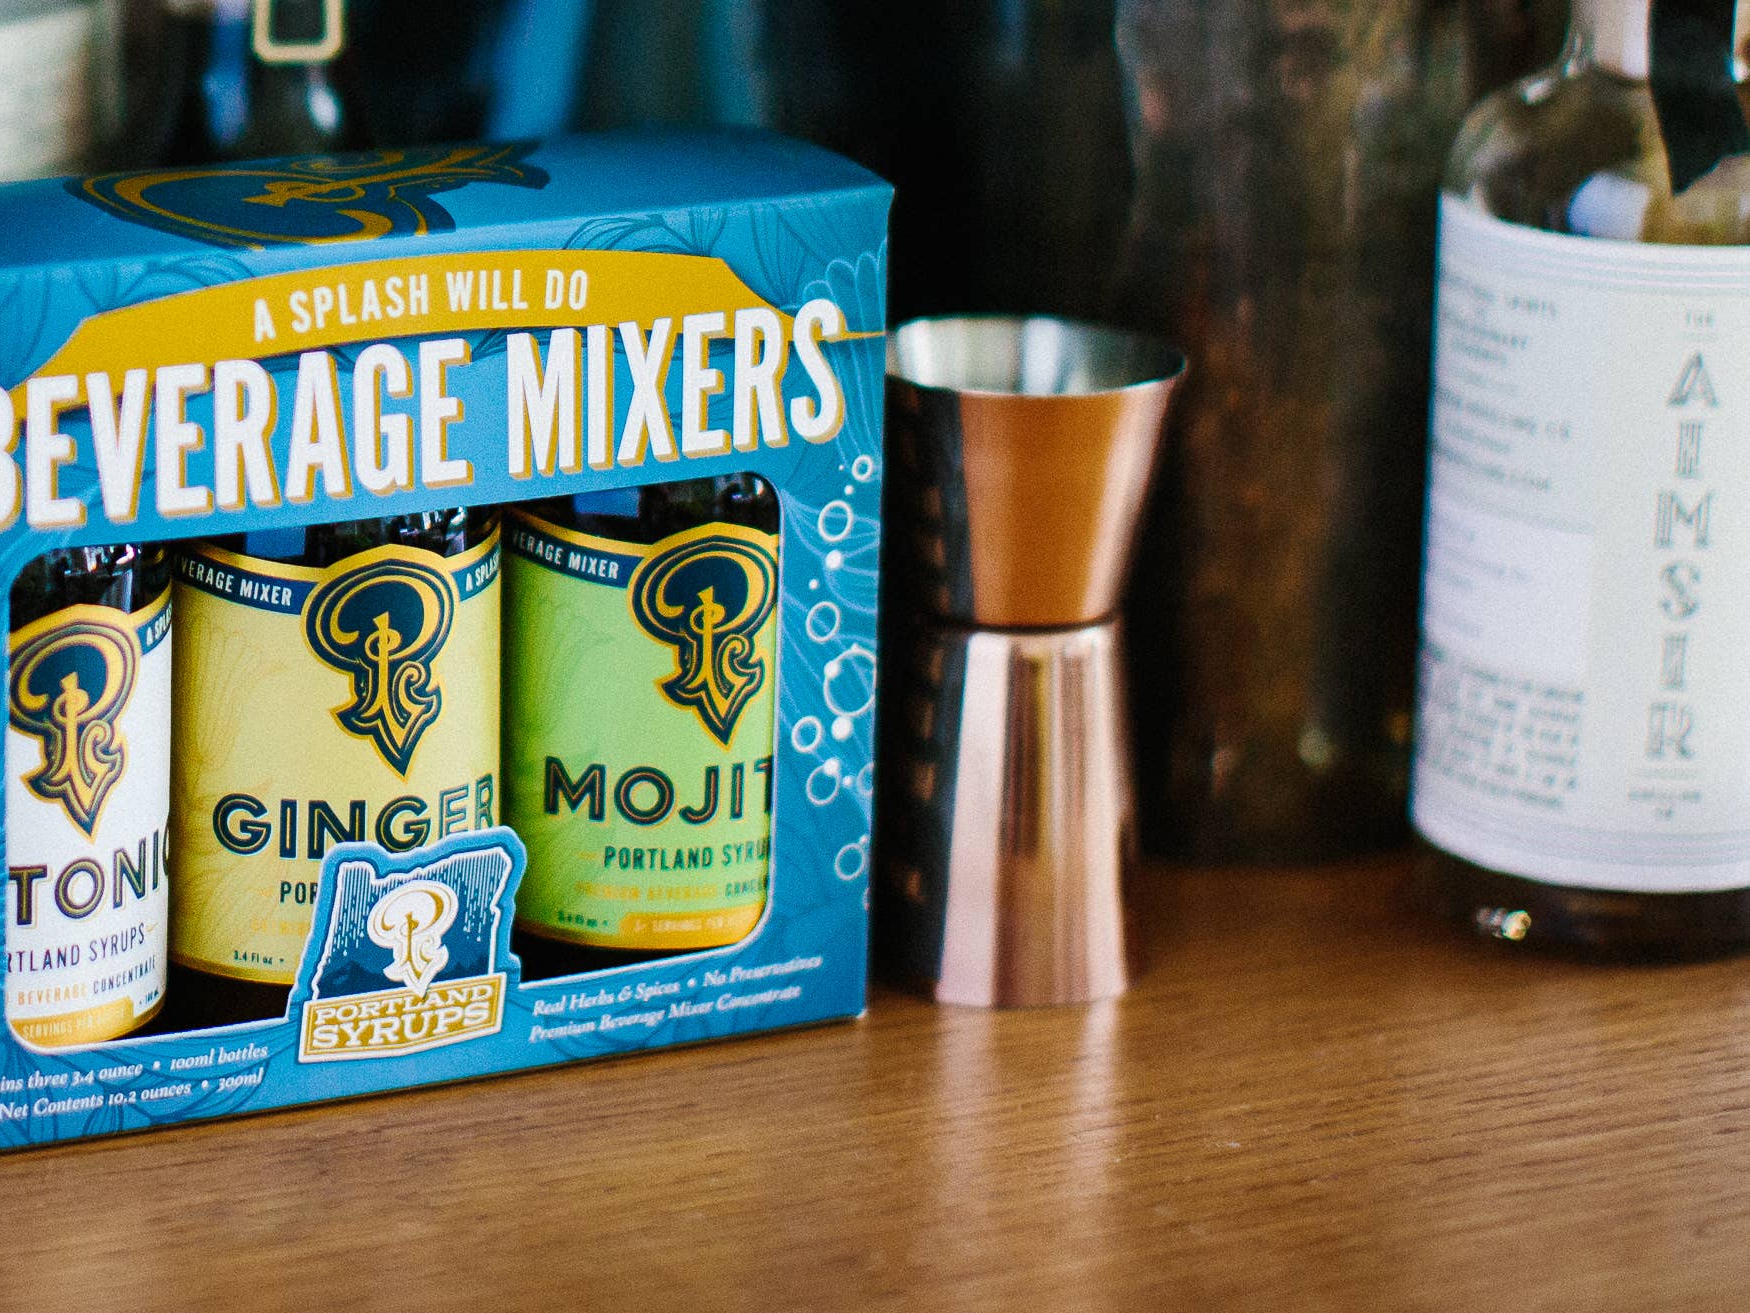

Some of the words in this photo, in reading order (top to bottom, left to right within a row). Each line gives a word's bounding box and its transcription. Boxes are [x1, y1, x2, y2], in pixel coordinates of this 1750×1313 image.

[253, 303, 276, 342] A
[290, 283, 430, 333] SPLASH
[448, 273, 531, 312] WILL
[544, 268, 589, 311] DO
[506, 298, 849, 480] MIXERS
[567, 551, 620, 580] MIXER
[239, 576, 293, 607] MIXER
[603, 845, 714, 872] PORTLAND
[88, 922, 146, 963] SYRUPS
[314, 984, 493, 1025] PORTLAND
[532, 995, 567, 1017] Real
[569, 989, 615, 1011] Herbs
[617, 985, 634, 1002] &
[634, 980, 681, 1003] Spices
[702, 969, 728, 988] No
[729, 954, 824, 984] Preservatives
[312, 1000, 490, 1049] SYRUPS
[528, 1019, 596, 1043] Premium
[599, 1009, 667, 1031] Beverage
[668, 999, 715, 1021] Mixer
[716, 985, 804, 1012] Concentrate
[27, 1069, 69, 1088] three
[71, 1070, 95, 1087] 3.4
[99, 1062, 144, 1081] ounce
[170, 1048, 215, 1071] 100ml
[218, 1043, 269, 1068] bottles
[32, 1091, 105, 1117] Contents
[108, 1089, 138, 1108] 10.2
[140, 1080, 193, 1102] ounces
[217, 1067, 266, 1093] 300ml
